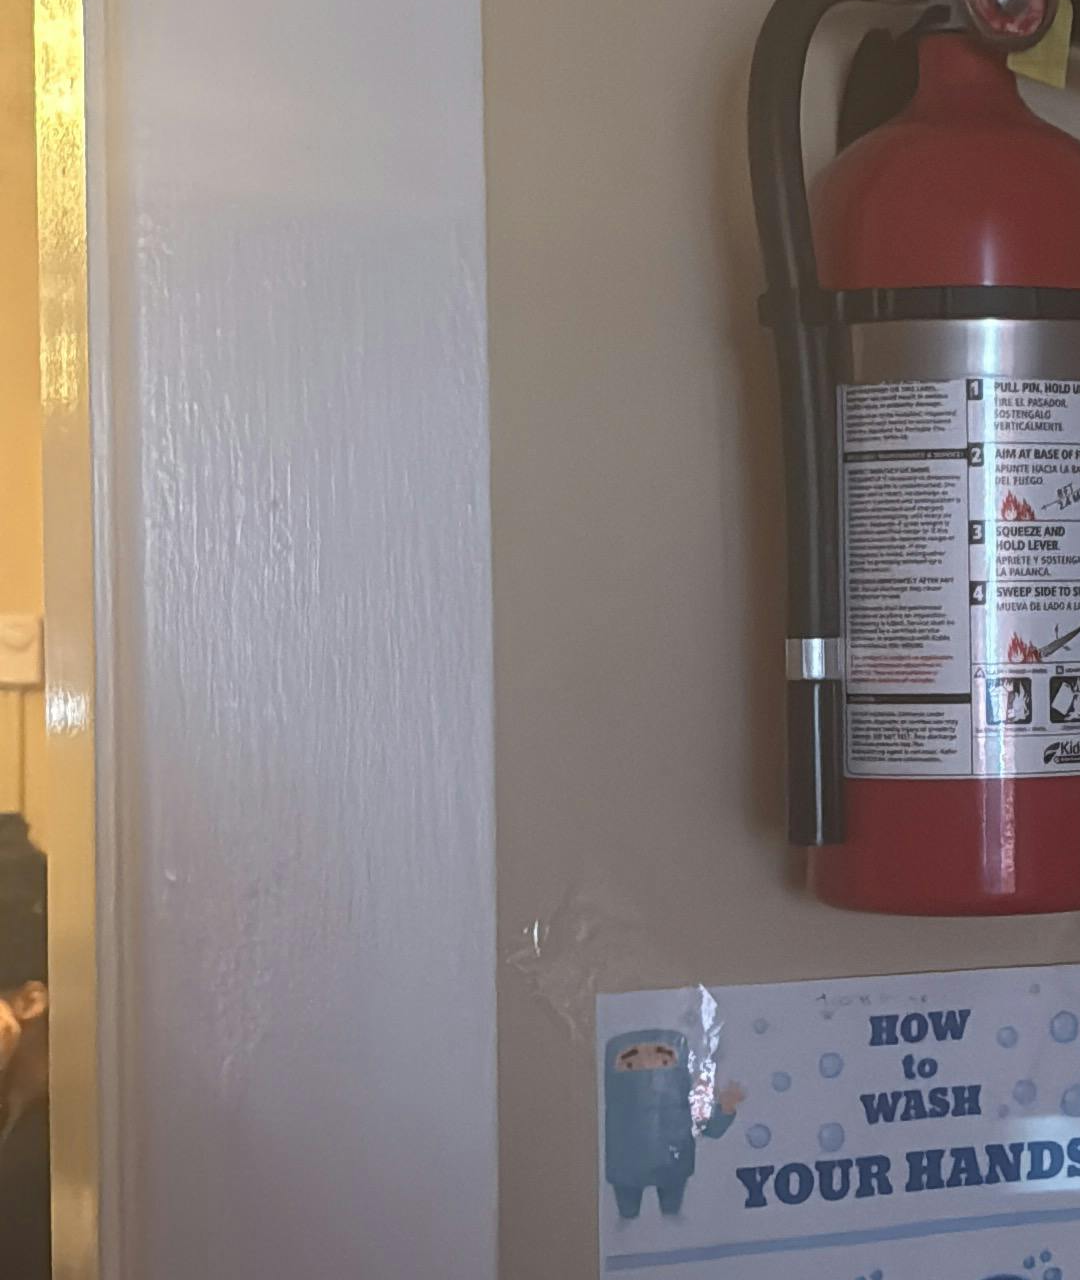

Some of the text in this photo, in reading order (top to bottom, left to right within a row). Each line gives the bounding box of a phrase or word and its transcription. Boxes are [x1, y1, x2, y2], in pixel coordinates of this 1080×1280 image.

[970, 381, 979, 397] 1
[994, 382, 1018, 394] PULL
[1044, 383, 1070, 395] HOLD
[1015, 398, 1025, 407] EL
[971, 448, 981, 463] 2
[995, 449, 1016, 460] AIM
[1018, 449, 1031, 460] AT
[1033, 449, 1059, 460] BASE
[1061, 449, 1073, 460] OF
[1060, 464, 1069, 474] LA
[972, 524, 982, 540] 3
[996, 526, 1066, 538] SQUEEZE AND
[996, 540, 1025, 551] HOLD
[1033, 556, 1039, 566] Y
[972, 585, 984, 601] 4
[997, 587, 1031, 598] SWEEP
[1034, 587, 1056, 598] SIDE
[1058, 587, 1071, 598] TO
[1030, 601, 1041, 611] DE
[1043, 601, 1064, 611] LADO
[1066, 601, 1072, 611] A
[868, 1009, 971, 1047] HOW
[902, 1053, 938, 1080] to
[860, 1084, 982, 1125] WASH
[735, 1154, 893, 1209] YOUR
